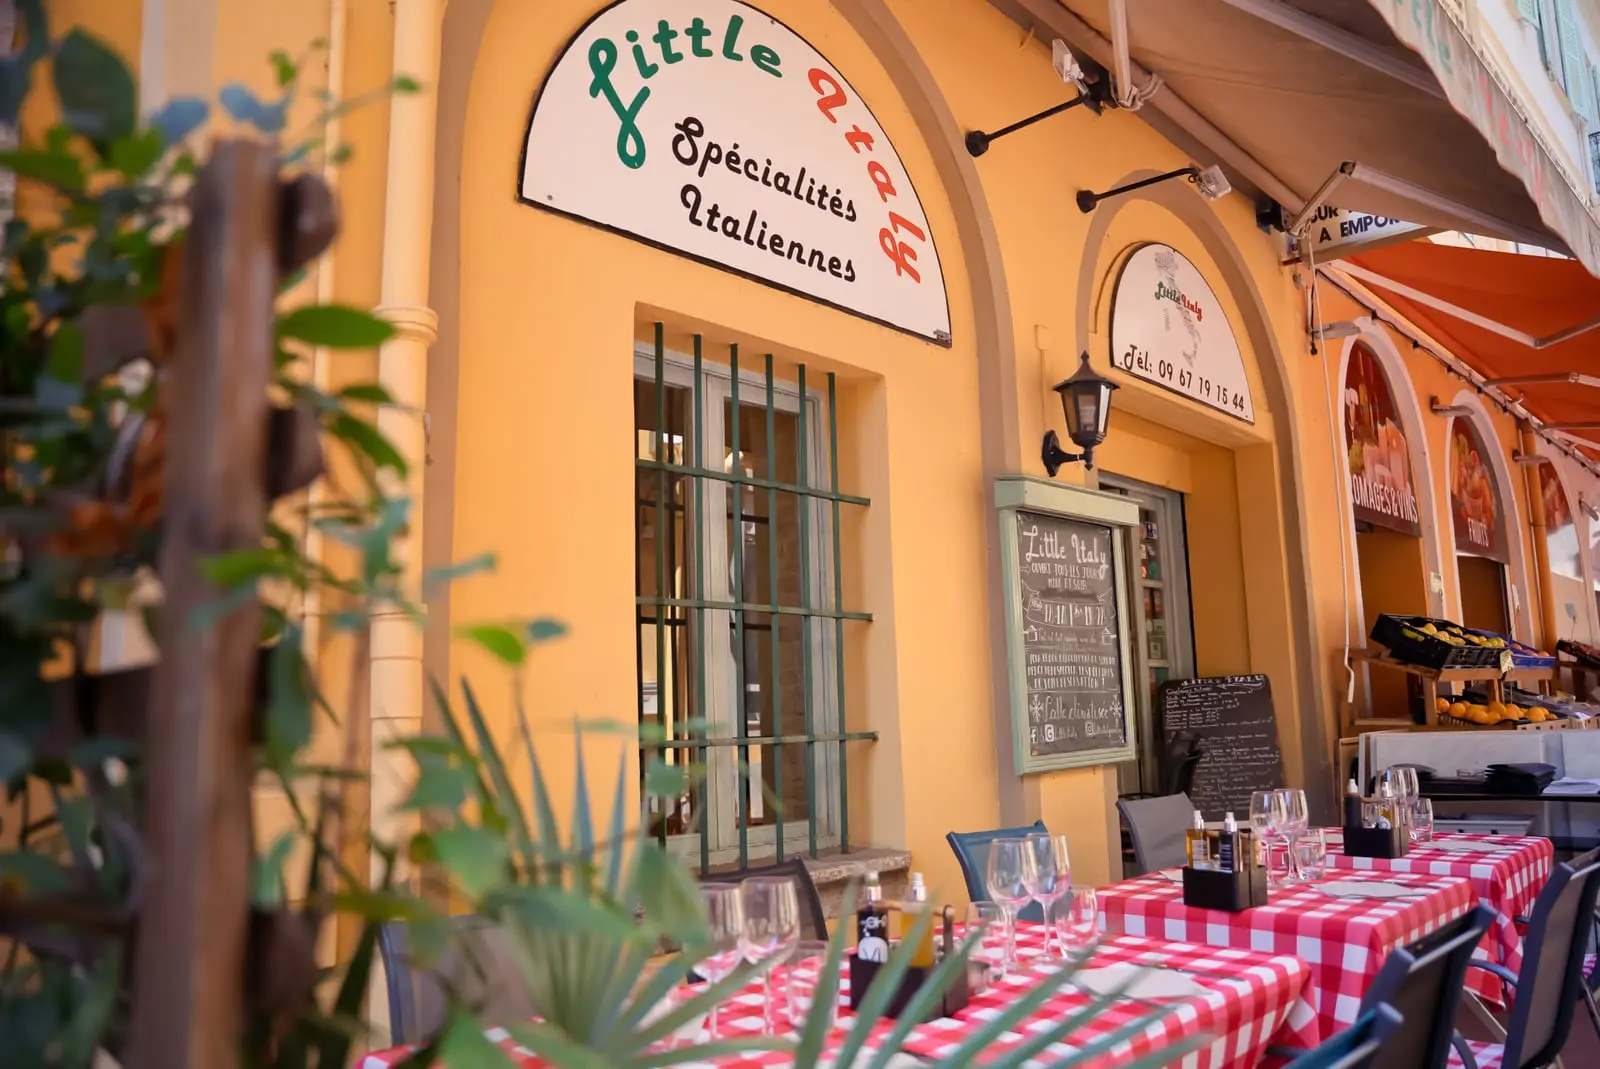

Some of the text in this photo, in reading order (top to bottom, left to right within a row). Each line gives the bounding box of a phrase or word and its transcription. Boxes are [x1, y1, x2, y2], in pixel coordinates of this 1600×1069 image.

[588, 15, 926, 284] Little Italy
[672, 116, 857, 223] Spécialités
[680, 184, 856, 282] Italiennes
[1319, 227, 1332, 243] A
[1158, 359, 1173, 381] 09
[1179, 368, 1192, 389] 67
[1199, 376, 1210, 397] 19
[1216, 385, 1228, 405] 15
[1232, 393, 1244, 411] 44
[1352, 474, 1418, 523] OMAGES&VINS
[1023, 525, 1108, 580] Little Italy
[1467, 517, 1489, 547] FRUITS
